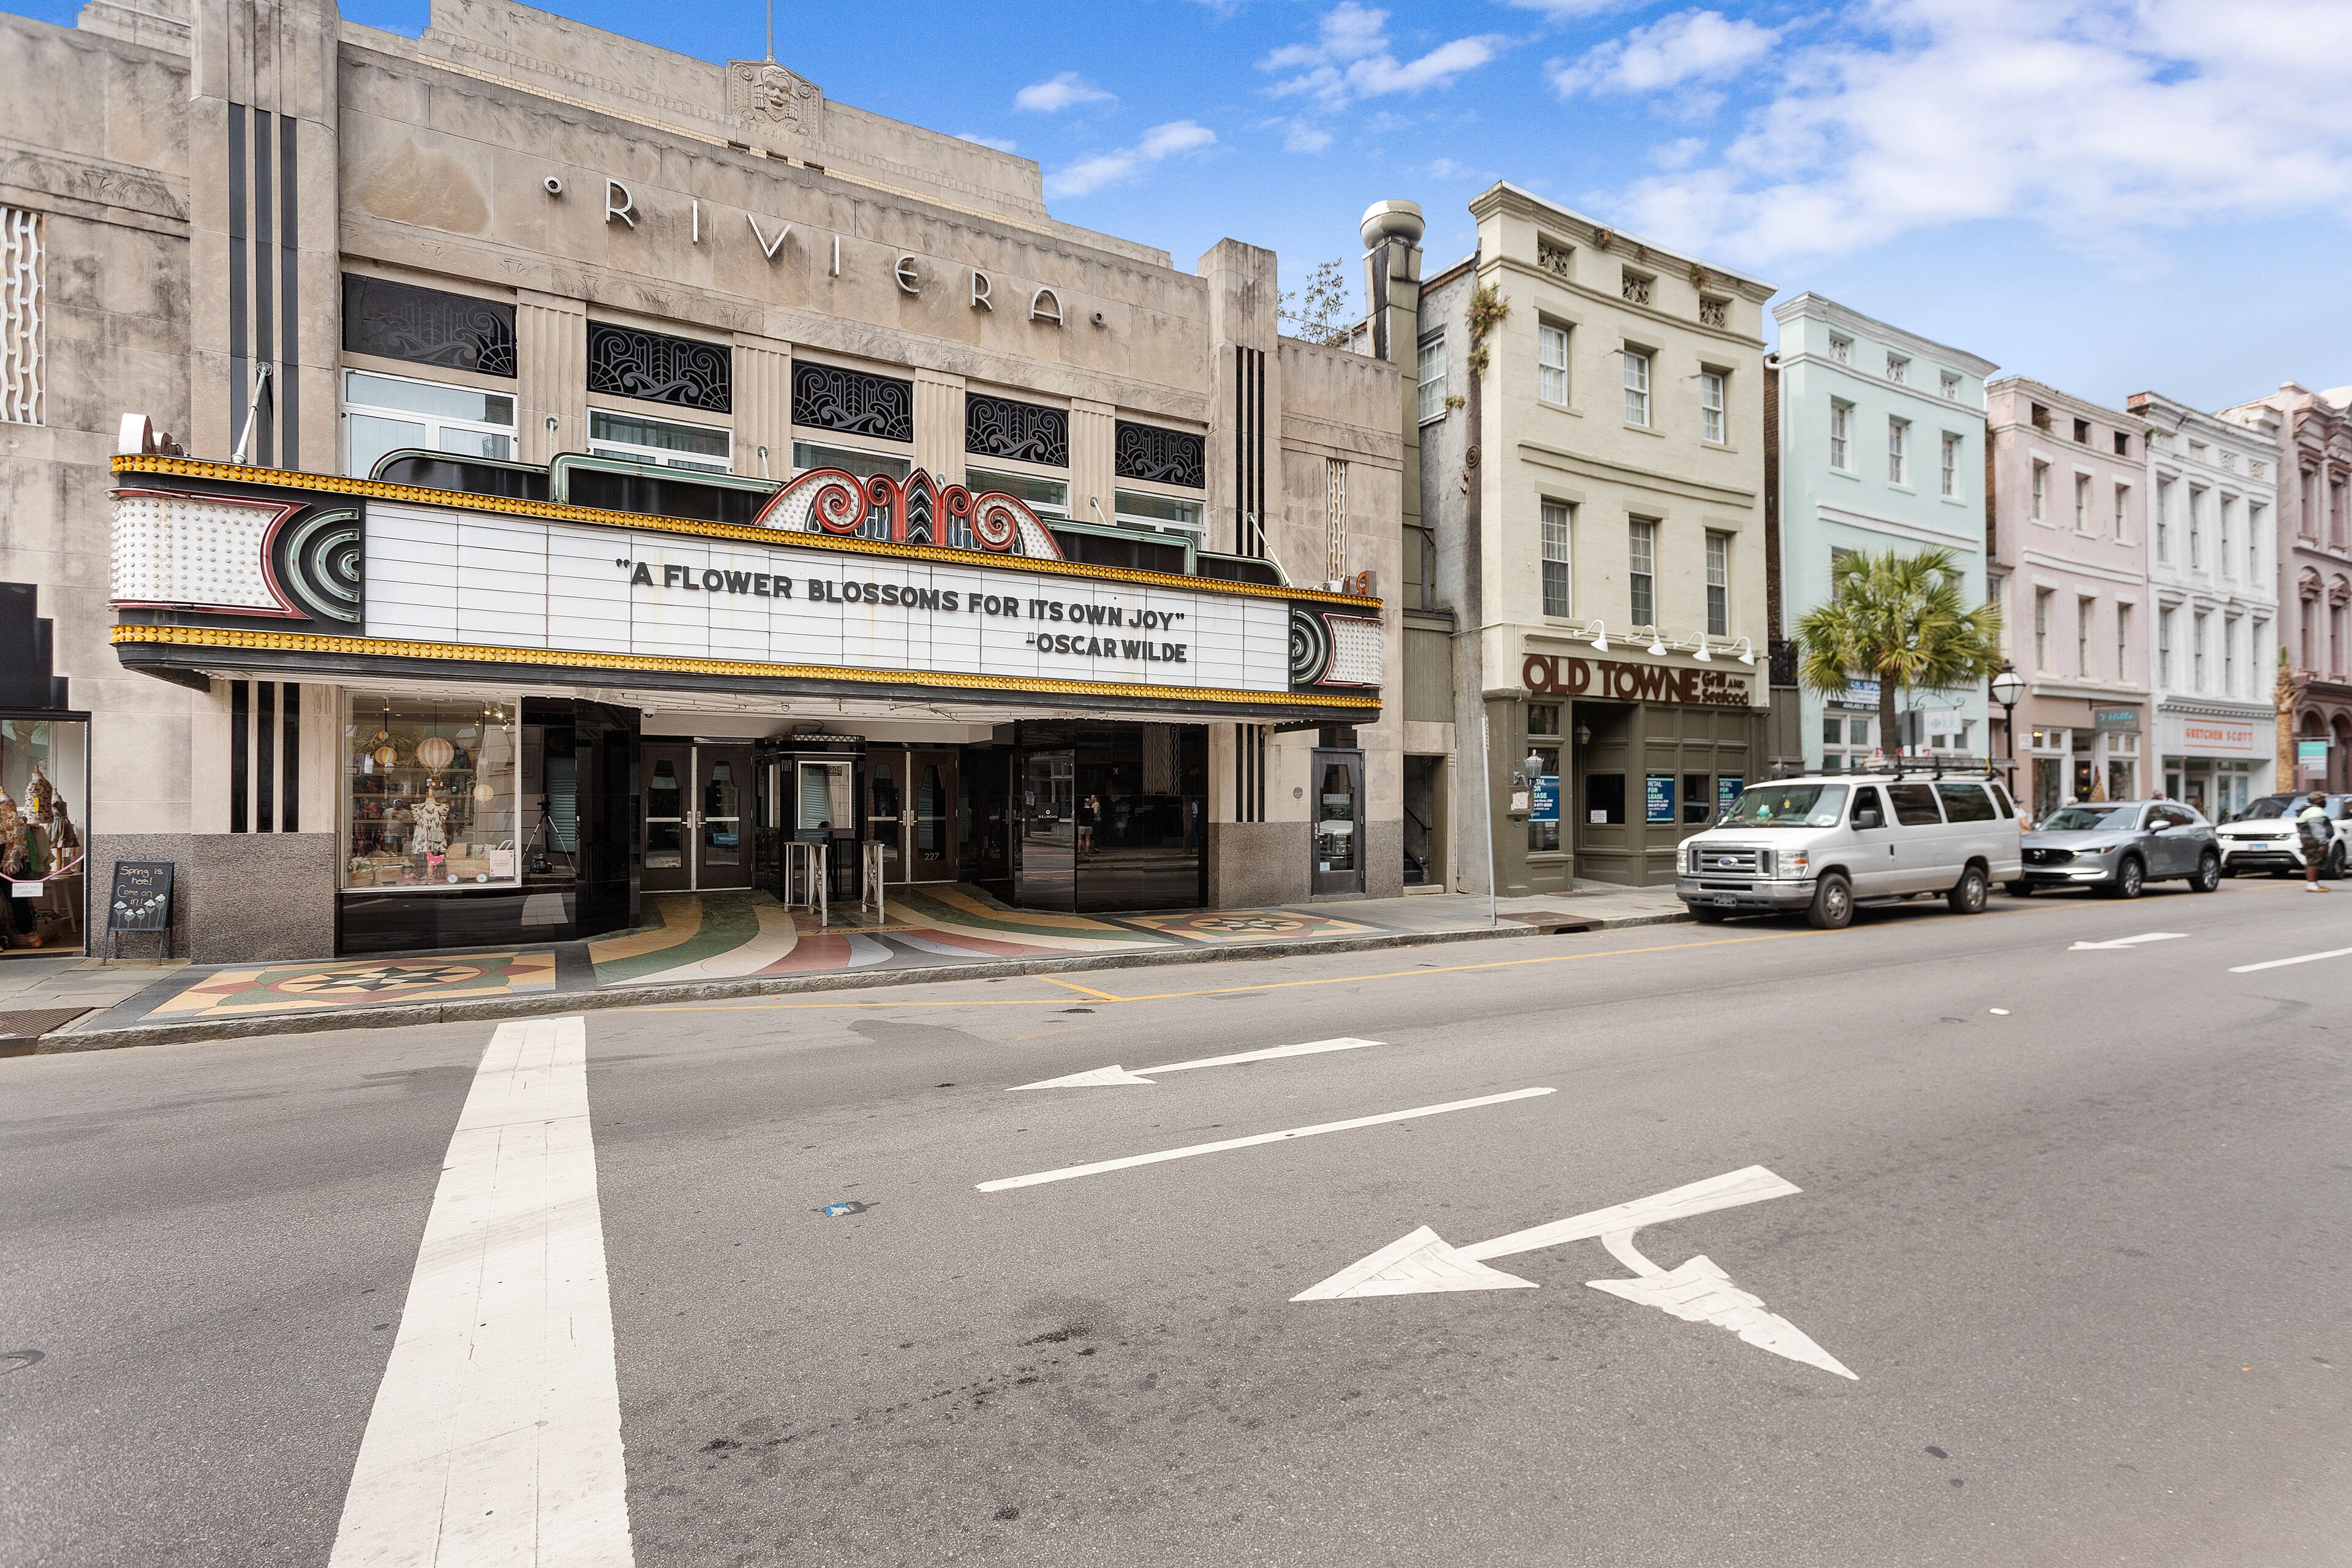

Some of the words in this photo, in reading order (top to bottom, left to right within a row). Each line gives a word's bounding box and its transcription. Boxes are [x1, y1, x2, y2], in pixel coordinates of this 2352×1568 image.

[605, 176, 1065, 328] RIVIERA
[664, 564, 793, 599] FLOWER
[808, 578, 959, 612] BLOSSOMS
[968, 592, 1019, 618] FOR
[1029, 598, 1065, 622] ITS
[1068, 603, 1122, 627] OWN
[1120, 639, 1188, 663] WILDE
[1523, 654, 1591, 693] OLD
[1597, 659, 1700, 703] TOWNE
[1702, 671, 1727, 687] Grill
[1727, 679, 1746, 689] AND
[1702, 687, 1749, 705] Seafood
[2185, 728, 2223, 740] GRETCHEN
[2226, 730, 2253, 741] SCOTT
[120, 865, 149, 878] Spring
[132, 877, 153, 886] here!
[117, 884, 138, 898] Come
[130, 897, 143, 907] in!
